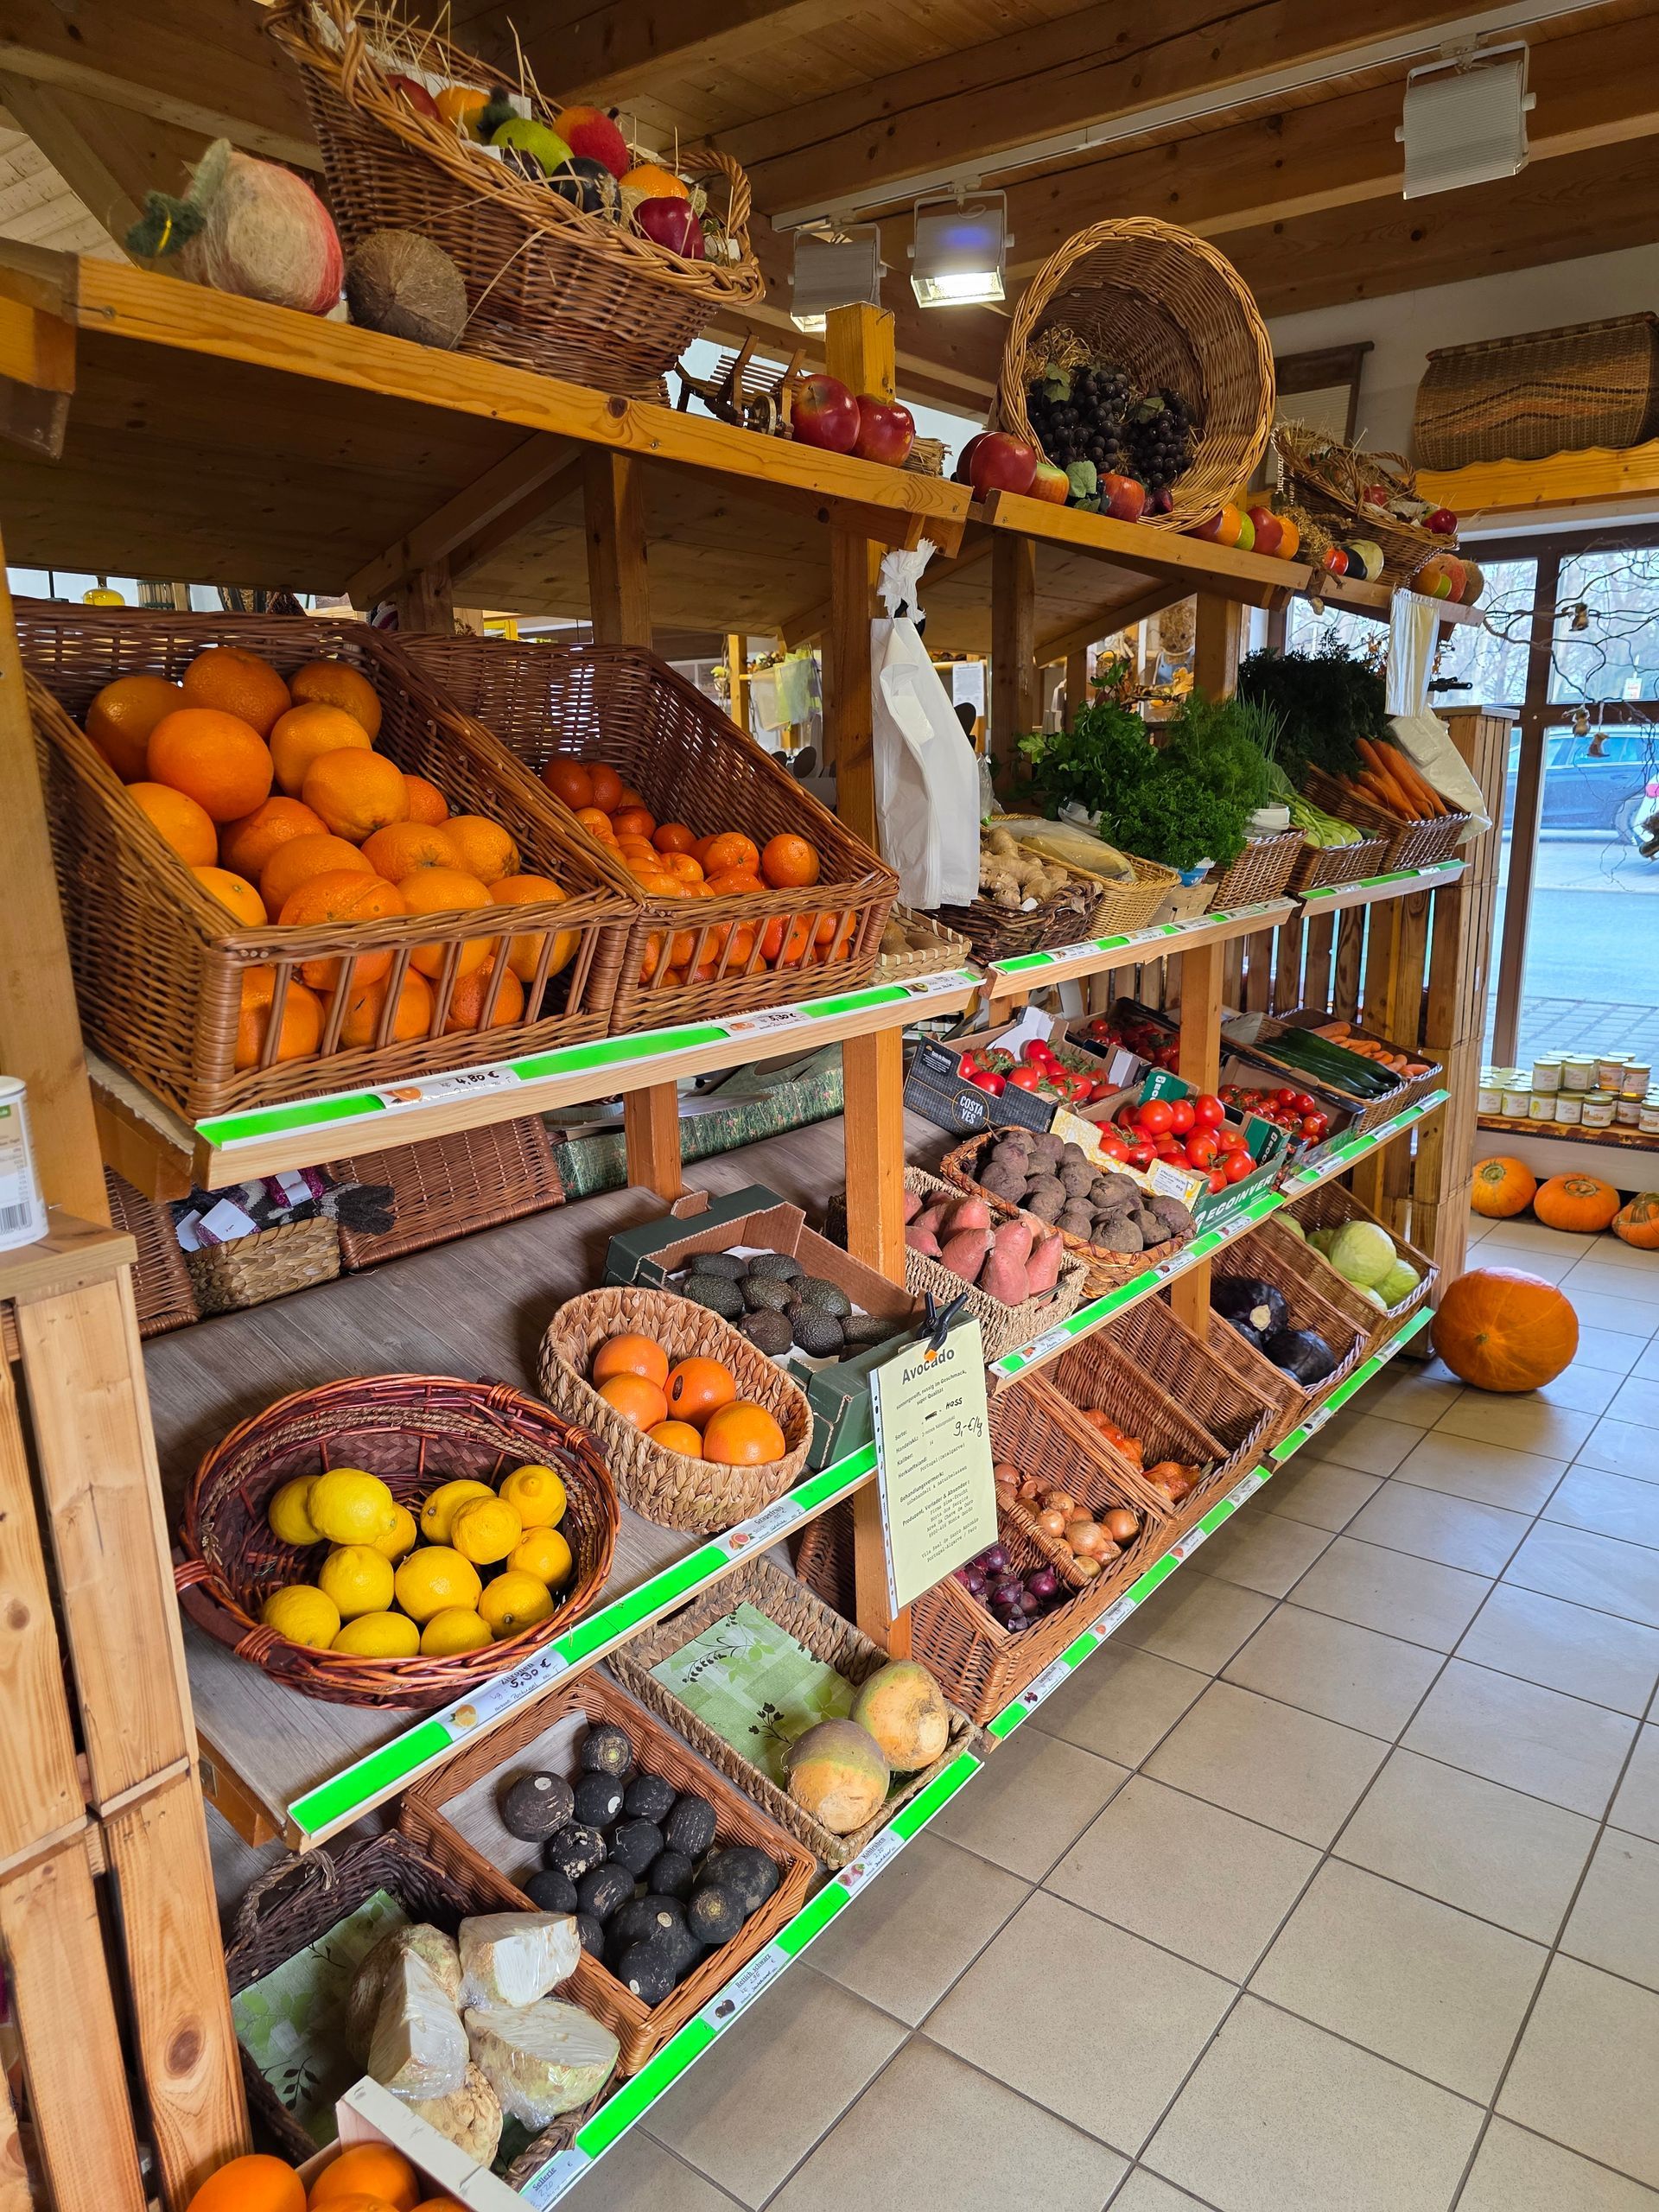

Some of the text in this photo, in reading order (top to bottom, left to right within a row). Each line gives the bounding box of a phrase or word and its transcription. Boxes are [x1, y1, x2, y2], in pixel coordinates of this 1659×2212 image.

[454, 1073, 486, 1086] 4,80
[487, 1070, 500, 1078] €
[960, 1096, 983, 1116] COSTA
[961, 1108, 976, 1124] YES
[1205, 1173, 1274, 1222] ECOINVER
[902, 1349, 954, 1384] Avocado
[940, 1370, 967, 1384] Geschmack,
[500, 1662, 535, 1684] Zitronen
[539, 1657, 552, 1669] €
[533, 2168, 556, 2190] Sellerie
